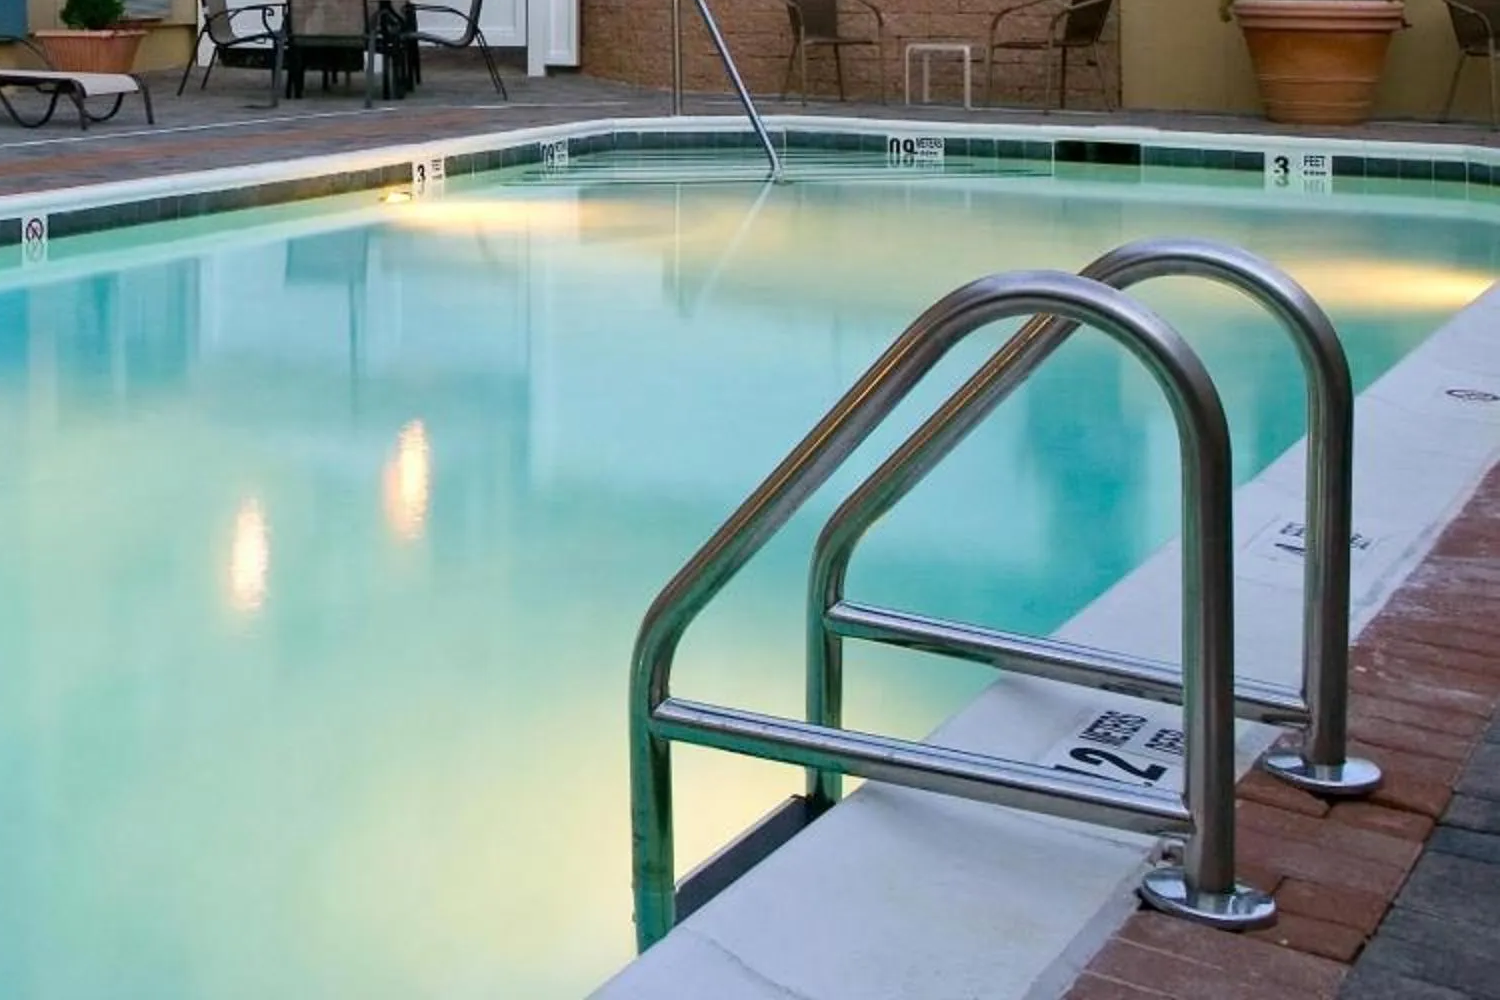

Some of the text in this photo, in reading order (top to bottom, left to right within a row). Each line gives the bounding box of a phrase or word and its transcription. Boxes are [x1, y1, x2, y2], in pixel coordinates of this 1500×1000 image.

[1274, 155, 1326, 175] 3 FEET
[1078, 710, 1148, 747] METERS
